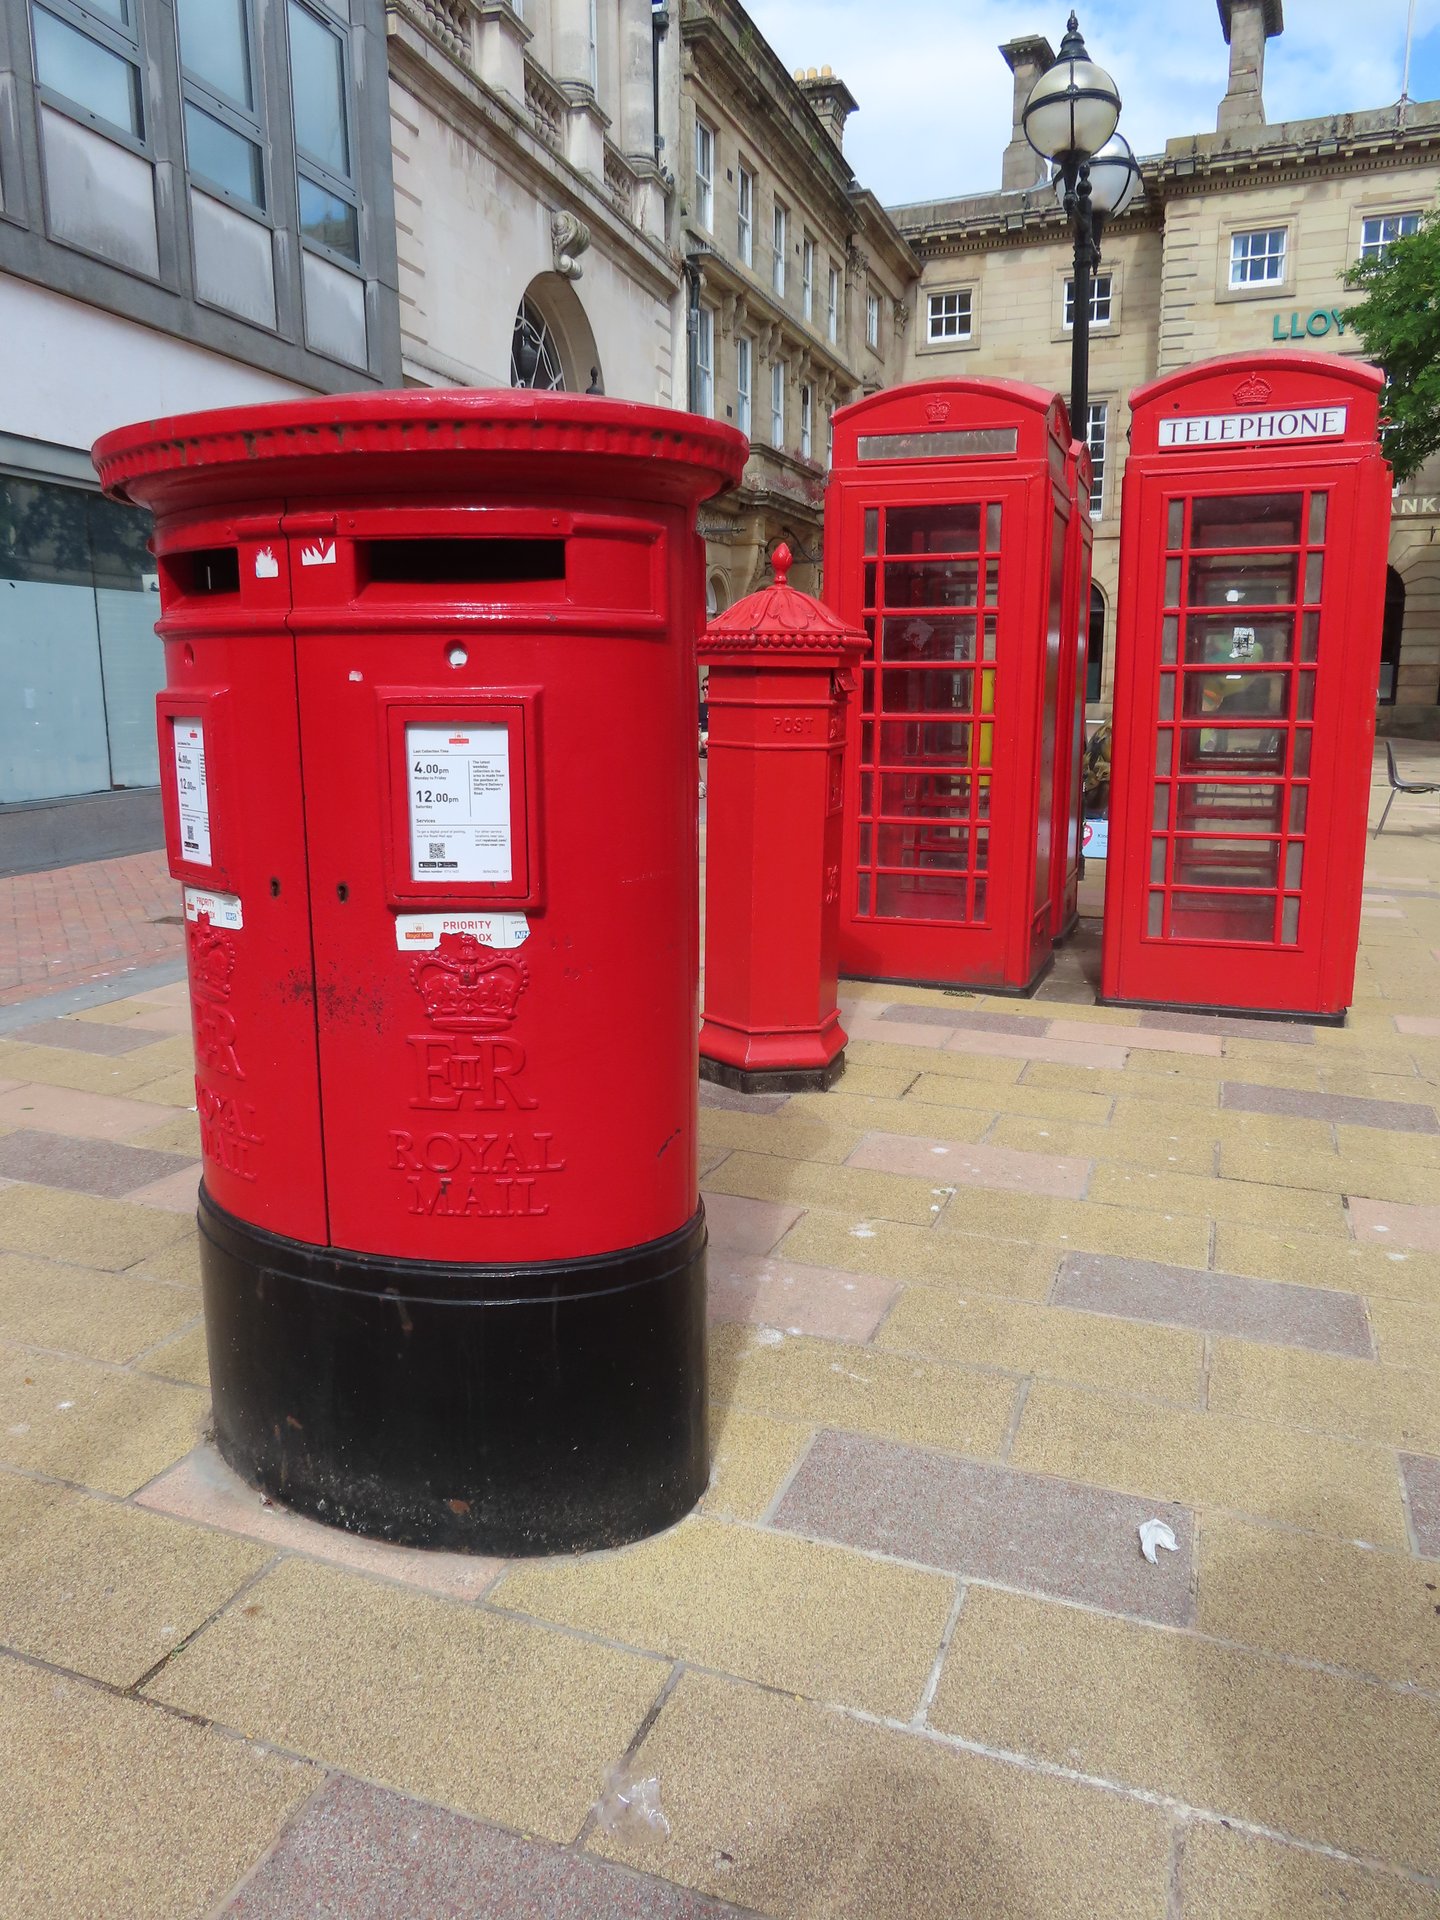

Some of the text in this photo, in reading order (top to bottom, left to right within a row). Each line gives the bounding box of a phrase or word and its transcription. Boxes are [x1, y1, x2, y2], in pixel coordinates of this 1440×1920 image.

[1273, 308, 1346, 341] LLOY
[1166, 411, 1339, 443] TELEPHONE
[772, 716, 815, 734] POST
[442, 920, 492, 931] PRIORITY
[514, 930, 529, 939] NH
[387, 1129, 567, 1175] ROYAL
[406, 1175, 550, 1218] MAIL
